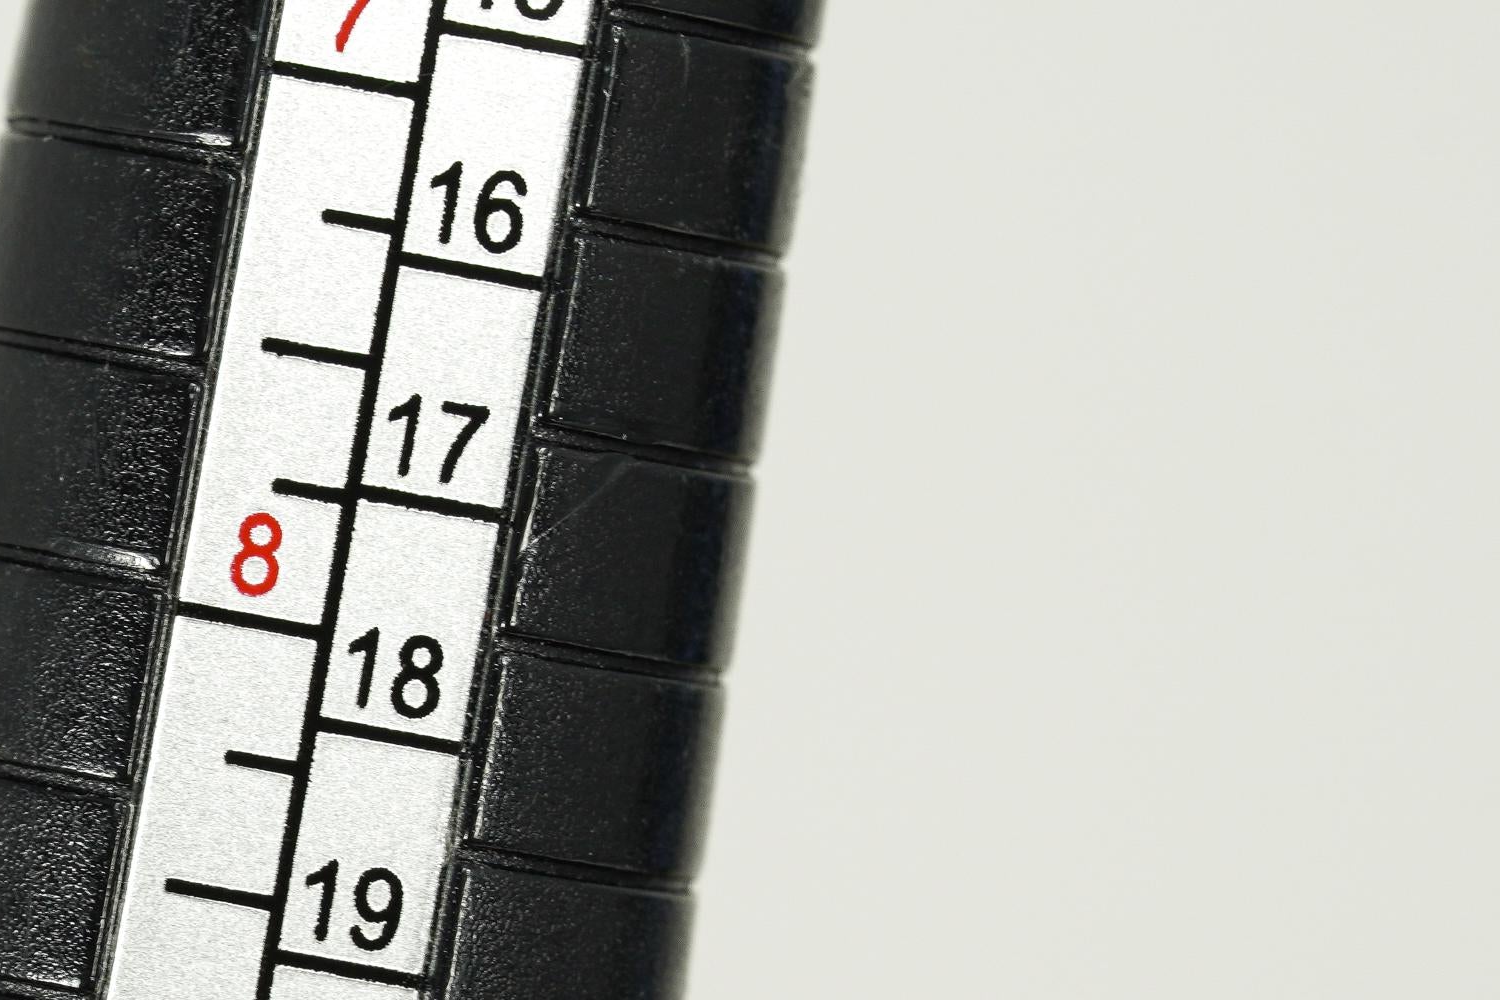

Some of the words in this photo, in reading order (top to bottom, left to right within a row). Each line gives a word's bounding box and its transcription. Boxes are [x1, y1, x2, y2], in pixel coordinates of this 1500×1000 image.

[430, 161, 528, 255] 16
[387, 393, 491, 484] 17
[230, 512, 283, 597] 8
[348, 626, 444, 719] 18
[305, 858, 404, 952] 19
